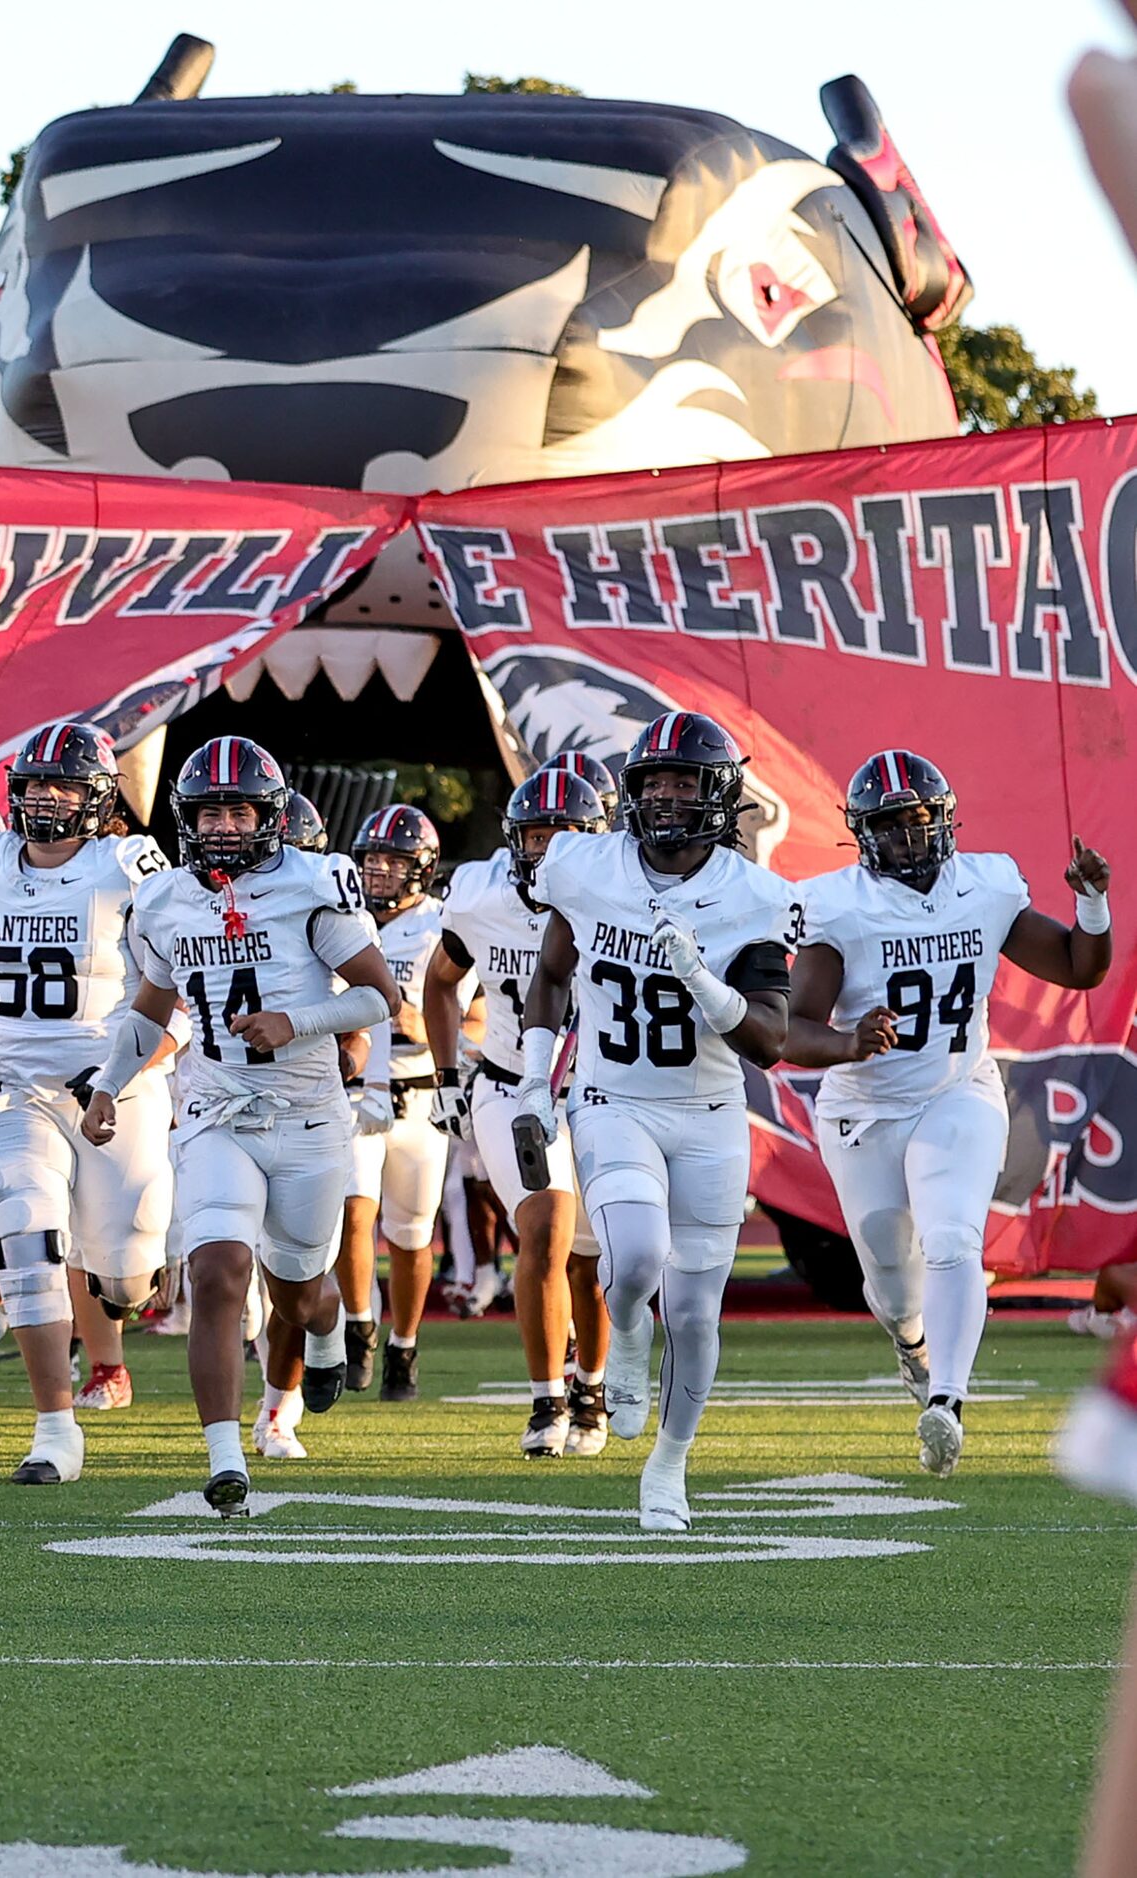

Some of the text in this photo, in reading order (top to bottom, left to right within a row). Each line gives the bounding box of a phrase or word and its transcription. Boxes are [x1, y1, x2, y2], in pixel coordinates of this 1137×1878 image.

[542, 467, 1137, 689] HERITA
[174, 930, 272, 968] PANTHERS
[881, 927, 984, 969] PANTHERS
[186, 966, 276, 1065] 14
[590, 959, 698, 1069] 38
[886, 961, 977, 1054] 94
